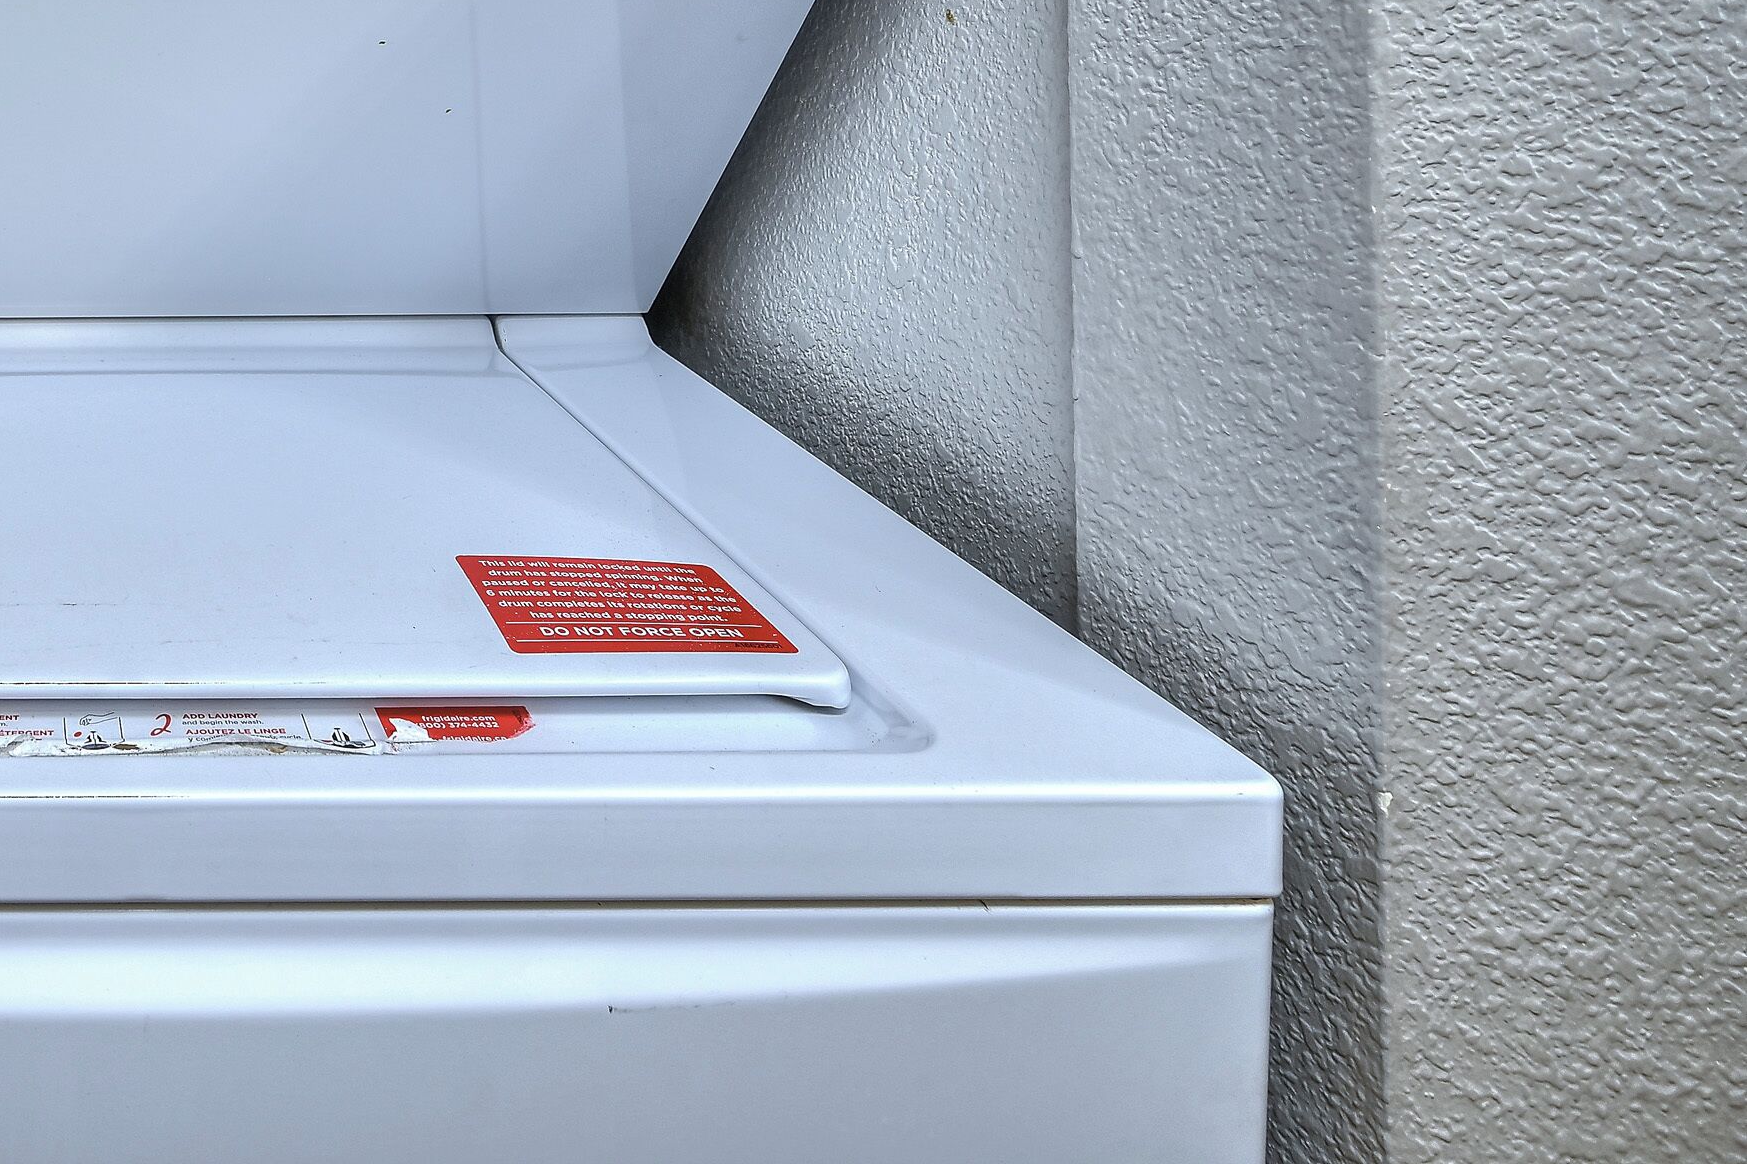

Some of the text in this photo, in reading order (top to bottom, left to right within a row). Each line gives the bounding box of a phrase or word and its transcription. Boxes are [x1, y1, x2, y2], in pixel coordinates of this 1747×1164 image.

[552, 562, 597, 570] remain
[597, 563, 641, 571] locked
[673, 567, 696, 575] the
[549, 570, 602, 579] stopped
[605, 573, 663, 582] spinning.
[663, 575, 703, 584] When
[629, 583, 656, 592] may
[658, 584, 688, 592] take
[709, 586, 725, 594] to
[553, 590, 572, 598] for
[574, 590, 597, 598] the
[601, 591, 629, 599] lock
[647, 593, 695, 601] release
[714, 595, 737, 604] the
[498, 600, 534, 608] drum
[536, 600, 606, 609] completes
[607, 601, 625, 609] its
[627, 603, 687, 611] rotations
[706, 605, 742, 613] cycle
[529, 611, 555, 619] has
[556, 611, 611, 619] reached
[625, 613, 686, 622] stopping
[687, 614, 728, 622] point.
[539, 626, 744, 638] DO NOT FORCE OPEN
[150, 713, 172, 737] 2
[449, 721, 500, 729] 374-4432
